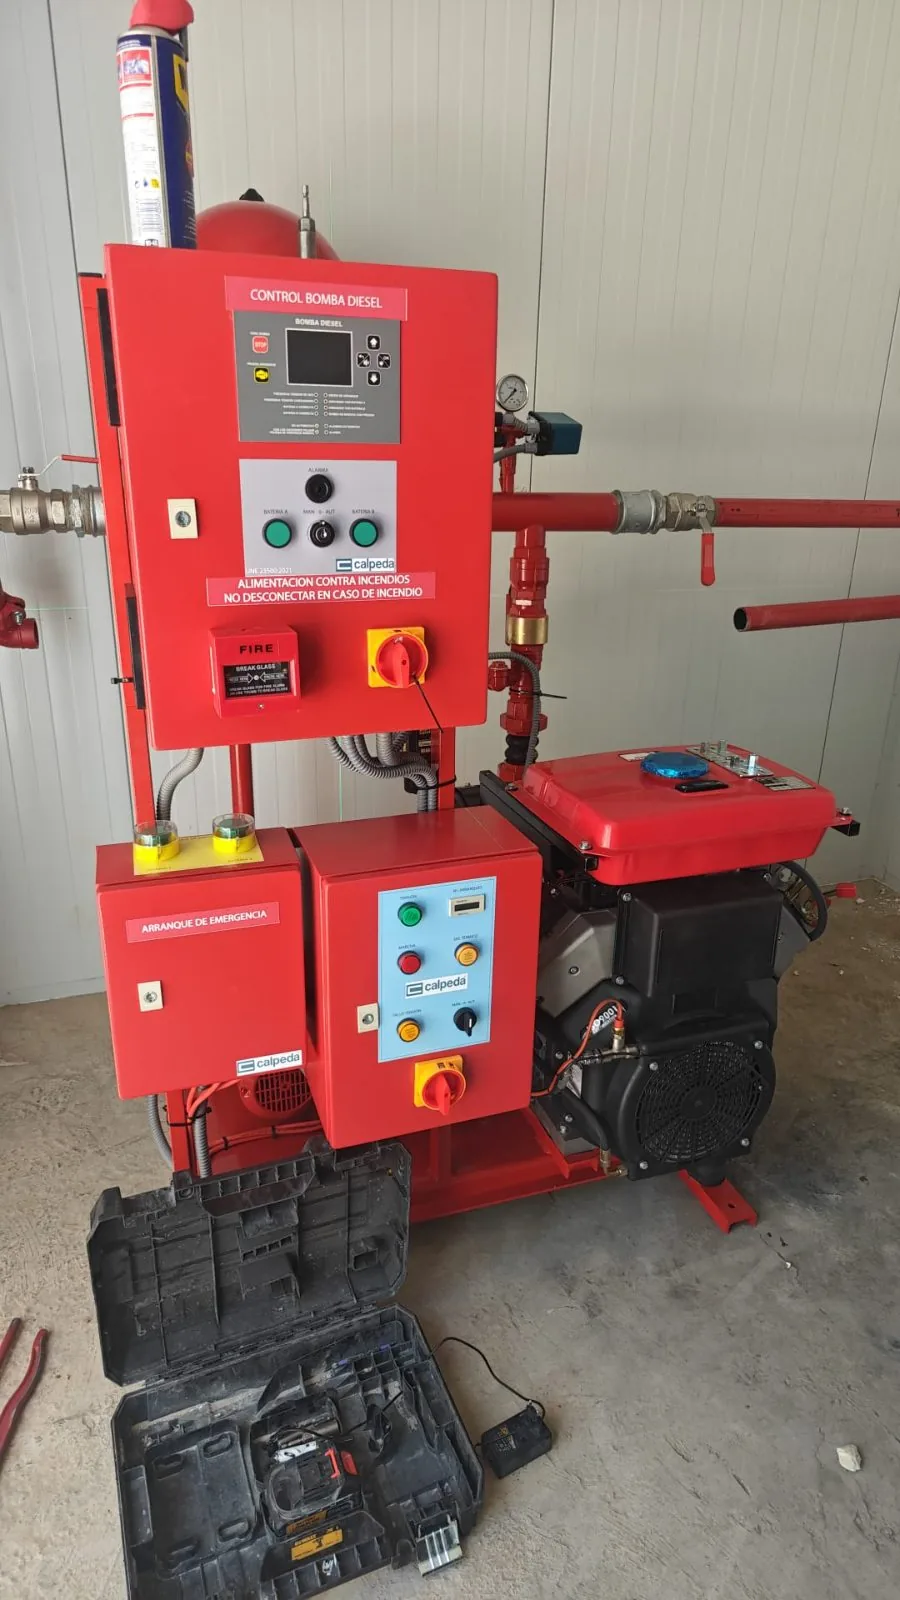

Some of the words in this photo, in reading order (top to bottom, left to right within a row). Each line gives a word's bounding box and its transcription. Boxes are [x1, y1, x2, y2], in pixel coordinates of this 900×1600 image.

[250, 288, 303, 304] CONTROL
[305, 292, 345, 306] BOMBA
[347, 296, 382, 309] DIESEL
[295, 318, 319, 326] BOMBA
[320, 319, 343, 328] DIESEL
[354, 558, 394, 572] calpeda
[237, 577, 314, 589] ALIMENTACION
[316, 576, 357, 587] CONTRA
[358, 574, 410, 585] INCENDIOS
[224, 593, 241, 603] NO
[244, 590, 315, 602] DESCONECTAR
[317, 590, 331, 600] EN
[332, 589, 360, 600] CASO
[361, 588, 375, 599] DE
[376, 587, 423, 599] INCENDIO
[240, 644, 273, 654] FIRE
[141, 919, 193, 933] ARRANQUE
[195, 918, 208, 927] DE
[209, 910, 267, 925] EMERGENCIA
[424, 976, 466, 991] calpeda
[256, 1051, 300, 1069] calpeda
